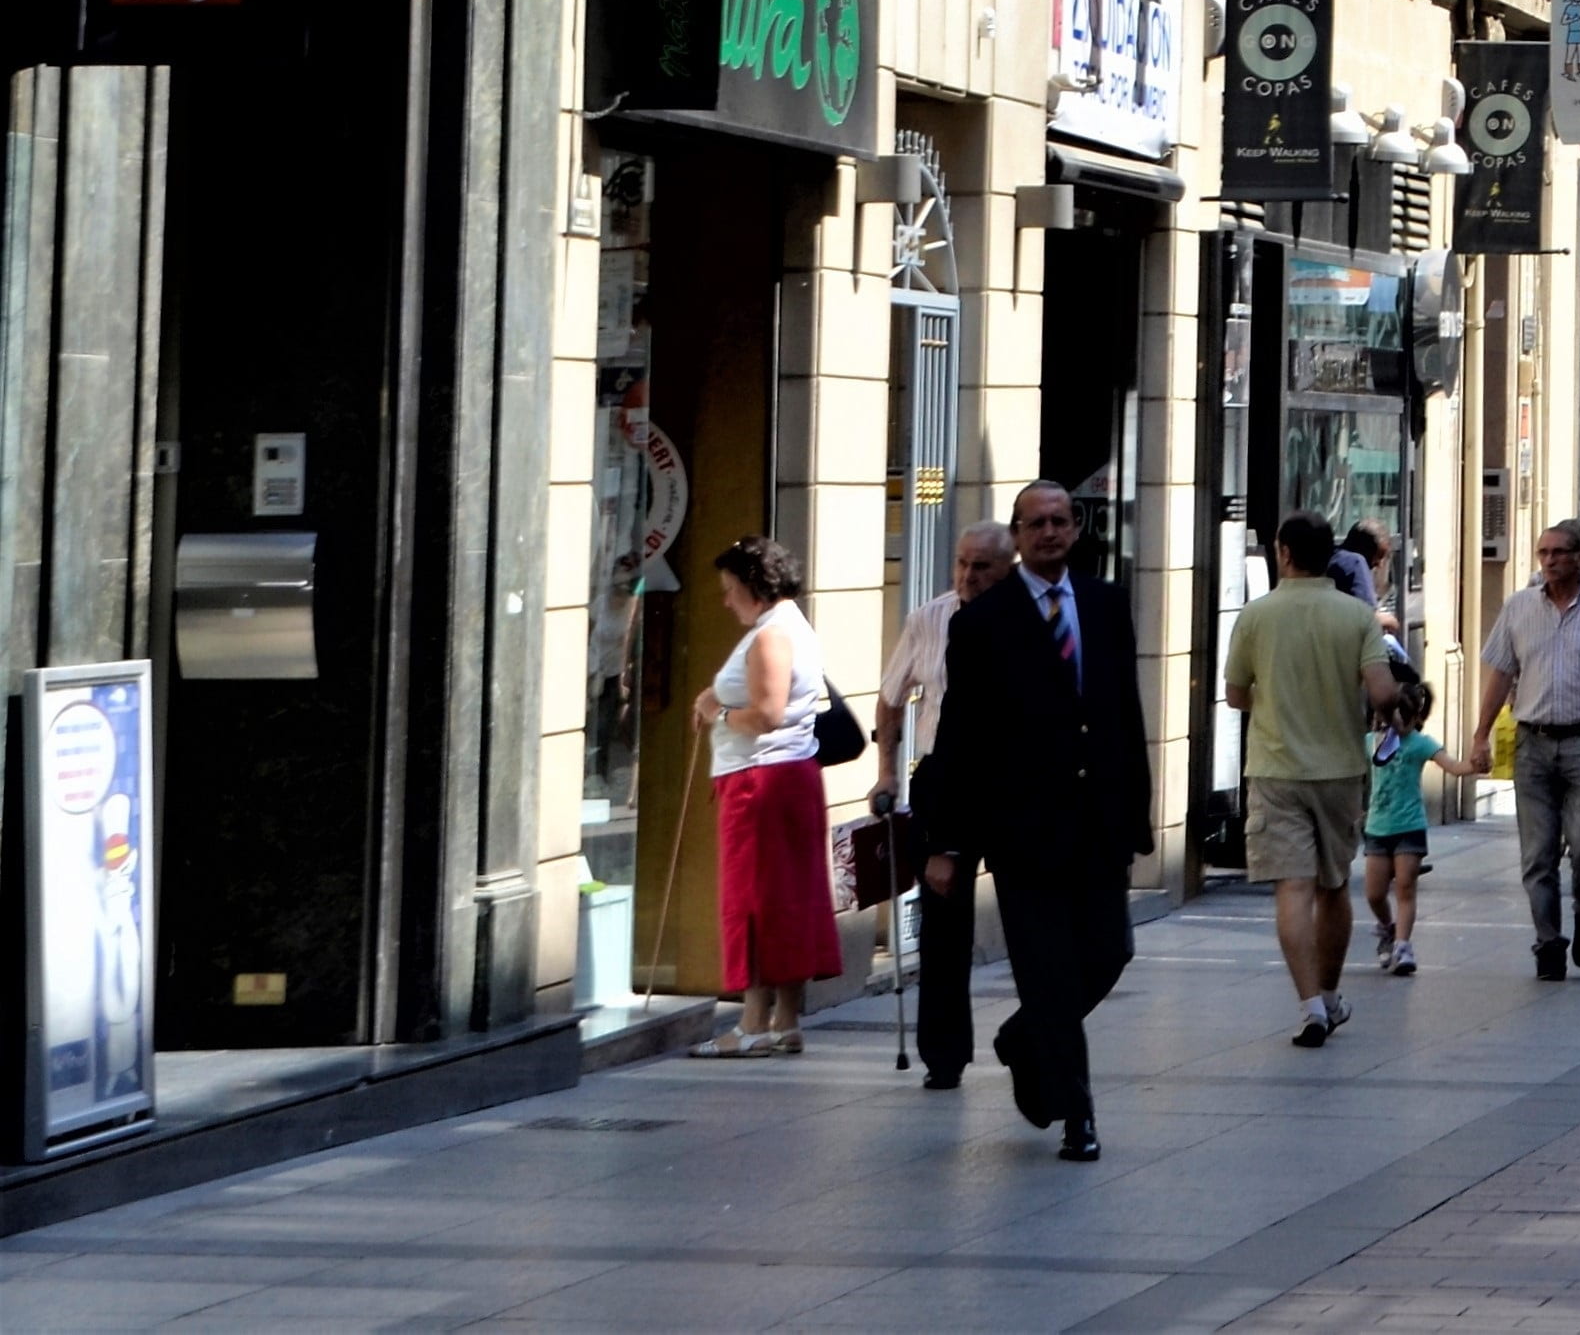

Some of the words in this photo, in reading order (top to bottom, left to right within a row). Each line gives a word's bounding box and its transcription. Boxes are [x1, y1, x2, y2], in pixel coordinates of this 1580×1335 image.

[1242, 75, 1313, 97] COPAS
[1470, 79, 1534, 102] CAFES
[1471, 151, 1526, 169] COPAS
